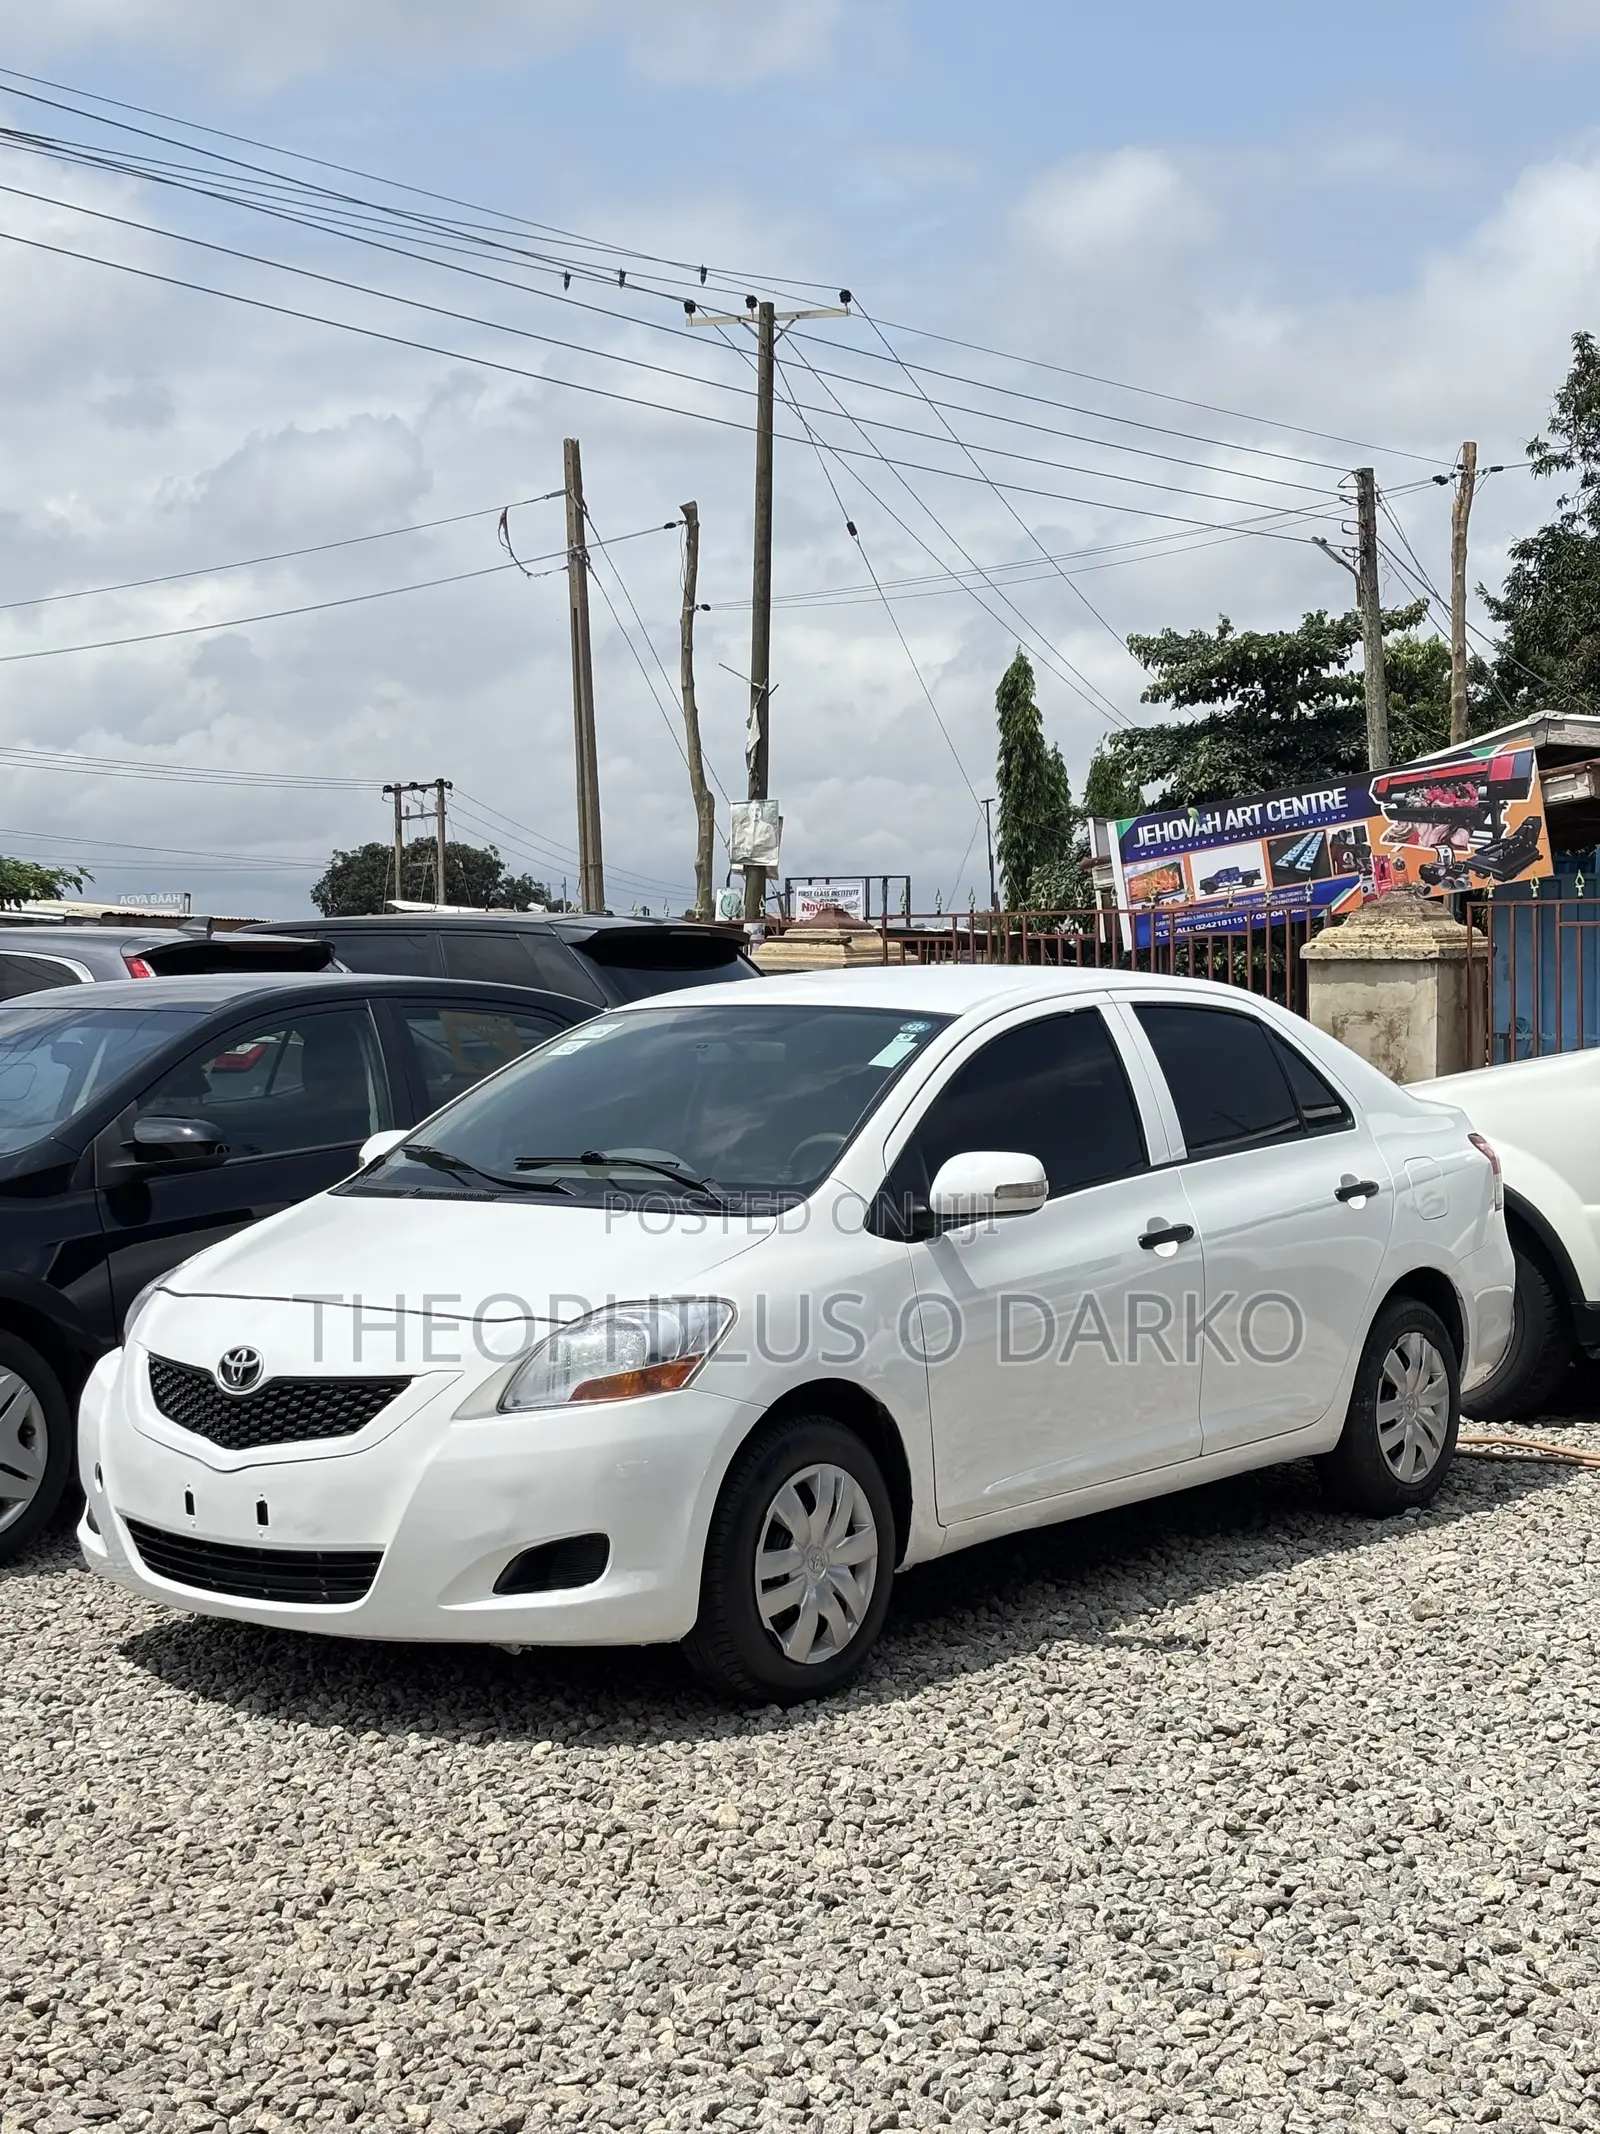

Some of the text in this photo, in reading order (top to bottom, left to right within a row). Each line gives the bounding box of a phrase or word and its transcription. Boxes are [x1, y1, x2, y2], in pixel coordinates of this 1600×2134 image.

[1132, 787, 1349, 848] JEHOVAH ART CENTRE
[1163, 838, 1215, 853] PROVIDE
[1224, 827, 1276, 841] QUALITY
[1285, 813, 1347, 829] PRINTING
[120, 893, 181, 905] AGYA BAAH
[831, 889, 859, 898] INSTITUTE
